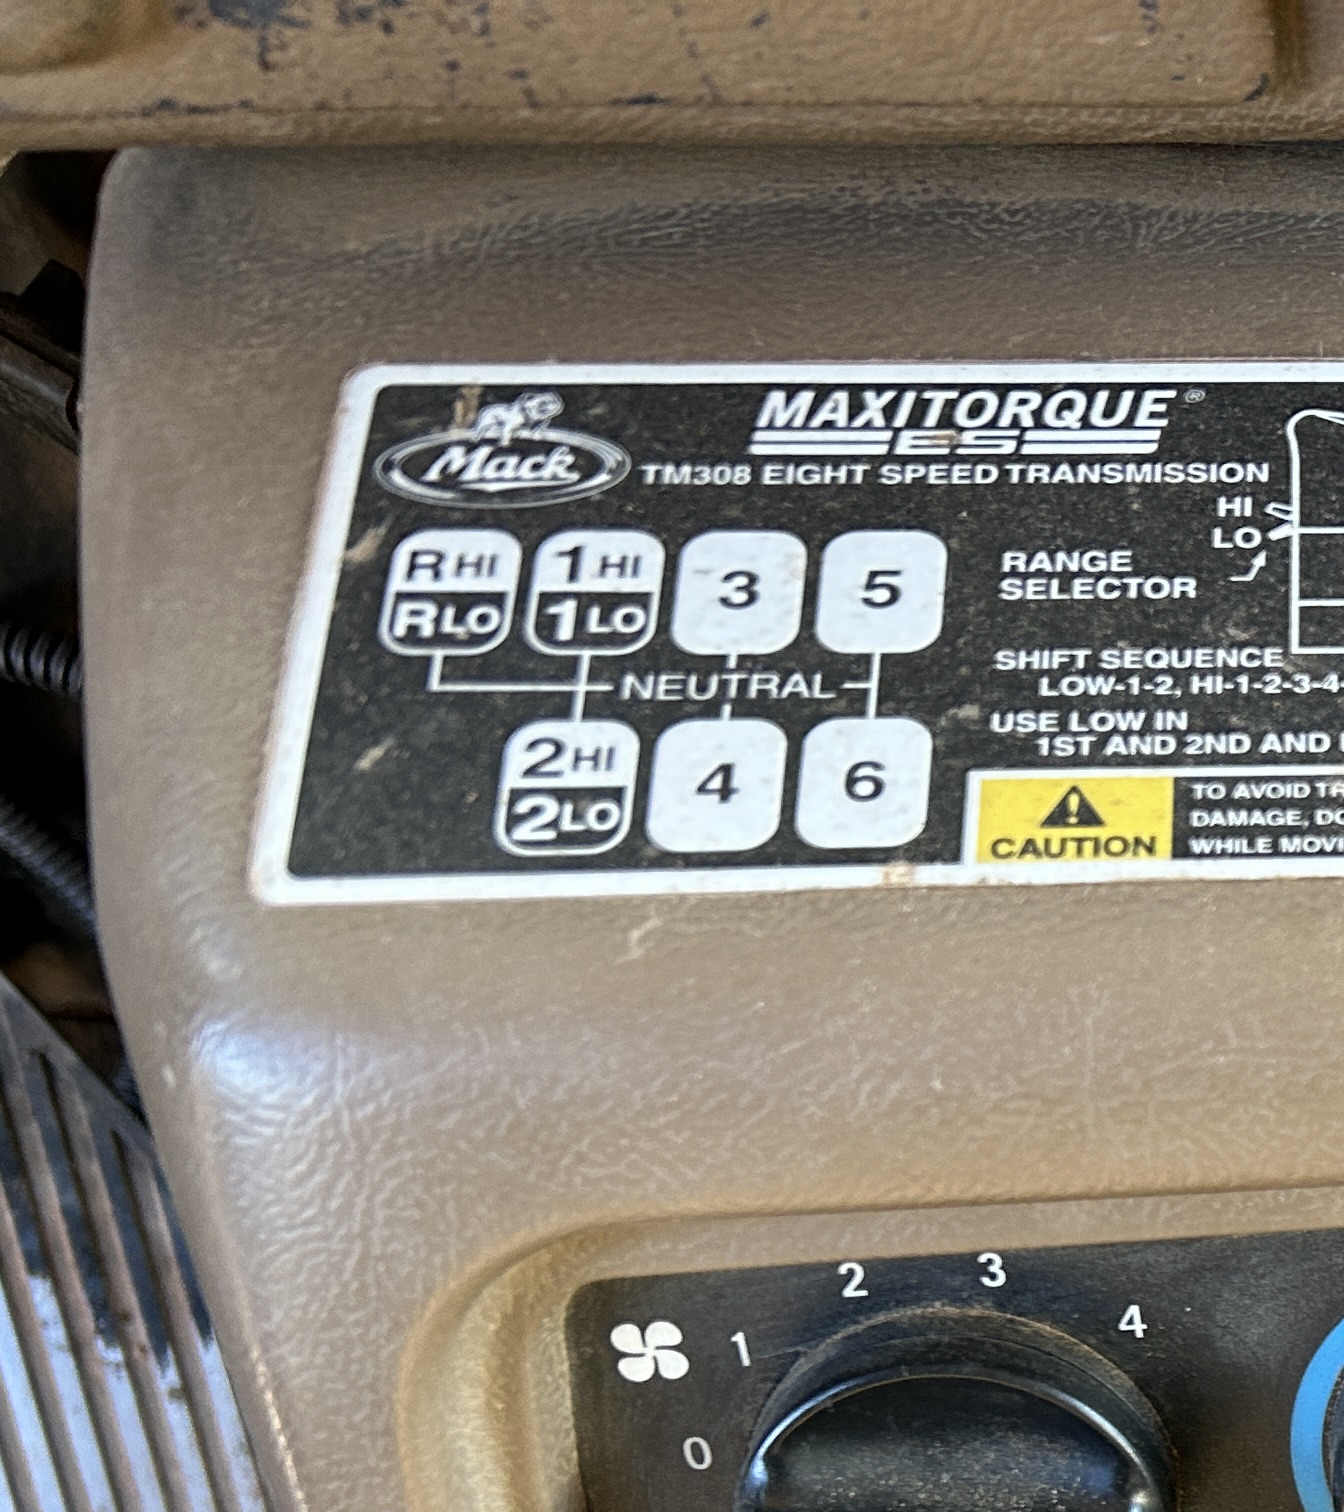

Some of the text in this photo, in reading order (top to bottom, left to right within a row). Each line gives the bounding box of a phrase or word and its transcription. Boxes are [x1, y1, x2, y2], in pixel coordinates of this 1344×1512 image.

[420, 445, 580, 491] Mack
[641, 462, 1270, 486] TM308 EIGHT SPEED TRANSMISSION
[1216, 495, 1252, 518] HI
[1211, 526, 1263, 549] LO
[1001, 550, 1134, 573] RANGE
[718, 570, 760, 610] 3
[860, 569, 902, 608] 5
[998, 576, 1197, 600] SELECTOR
[994, 647, 1285, 670] SHIFT SEQUENCE
[619, 671, 837, 700] NEUTRAL
[1038, 676, 1182, 699] LOW-1-2,
[989, 709, 1189, 734] USE LOW IN
[1035, 735, 1097, 758] 1ST
[1104, 734, 1177, 756] AND
[1183, 733, 1252, 756] 2ND
[1260, 731, 1331, 754] AND
[694, 762, 741, 804] 4
[844, 760, 886, 803] 6
[1191, 783, 1226, 801] TO
[1232, 781, 1312, 800] AVOID
[1189, 811, 1310, 831] DAMAGE,
[990, 835, 1158, 860] CAUTION
[1189, 836, 1273, 856] WHILE
[837, 1261, 870, 1299] 2
[976, 1251, 1008, 1289] 3
[1117, 1304, 1149, 1340] 4
[729, 1331, 752, 1367] 1
[682, 1437, 714, 1471] 0
